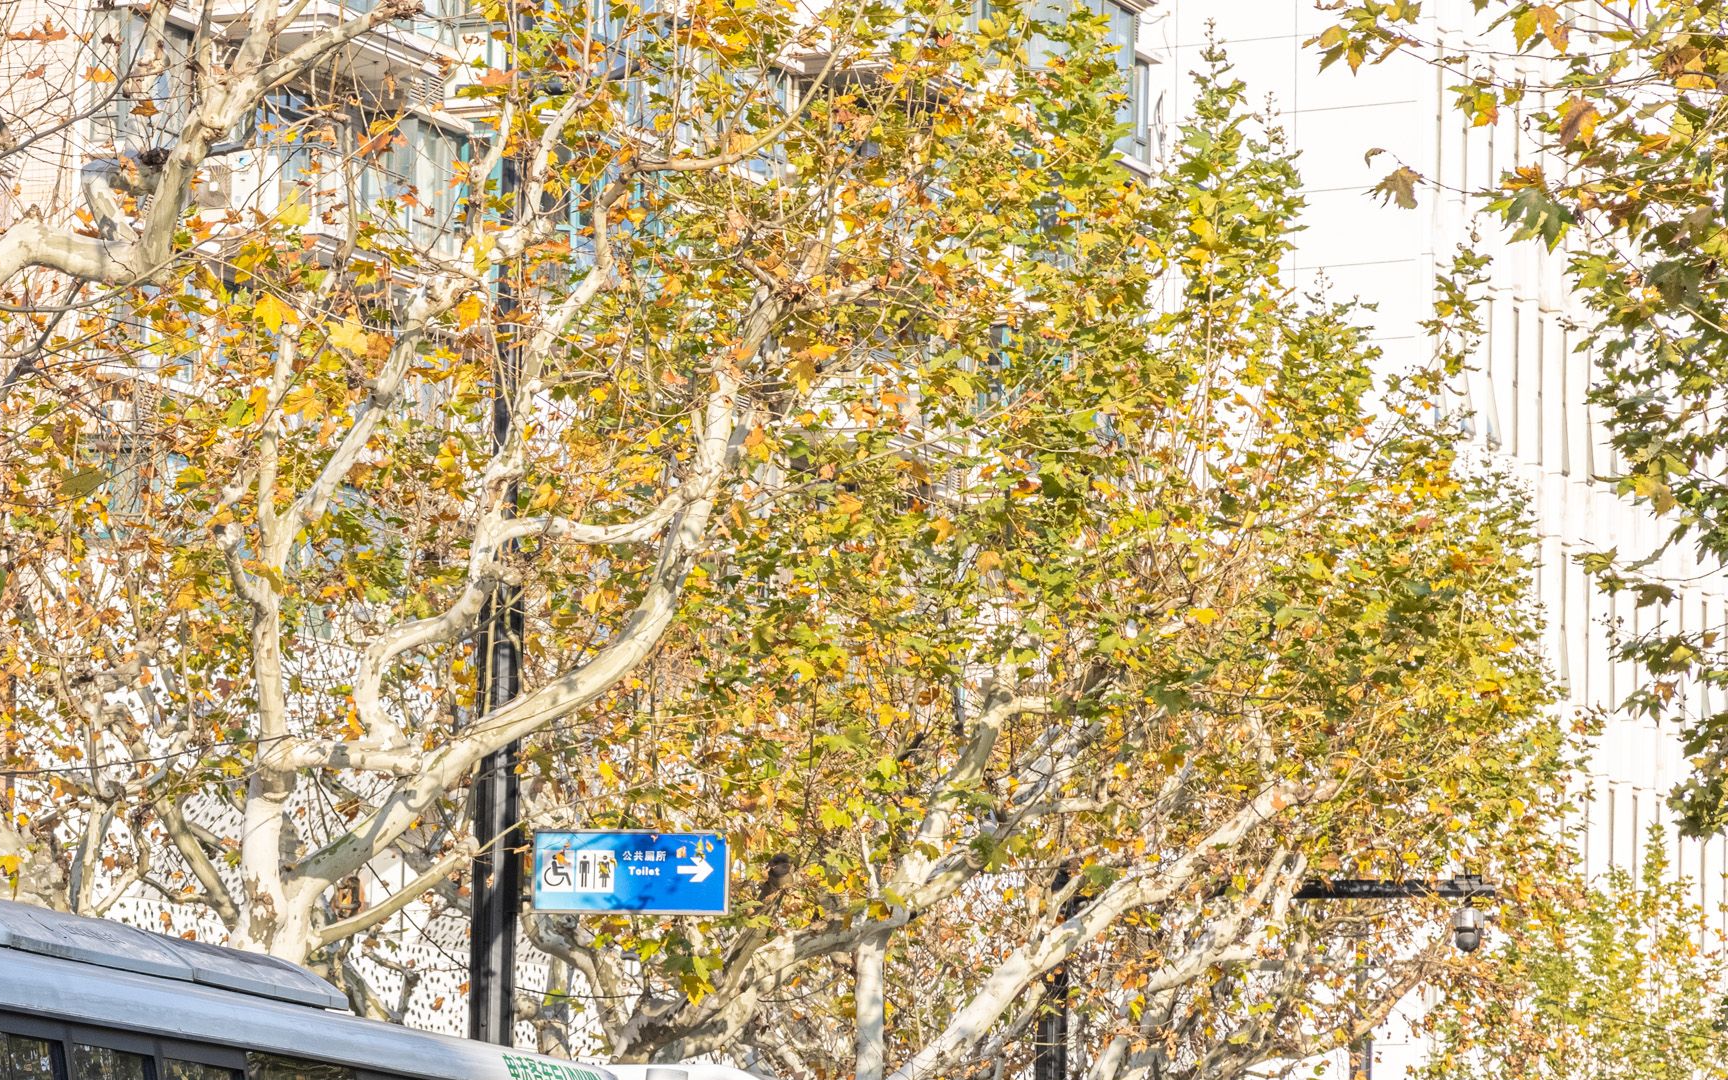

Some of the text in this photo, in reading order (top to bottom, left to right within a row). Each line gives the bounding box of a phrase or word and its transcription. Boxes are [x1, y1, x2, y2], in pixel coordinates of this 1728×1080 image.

[623, 850, 667, 862] 公共厕所
[628, 866, 660, 877] Toilet
